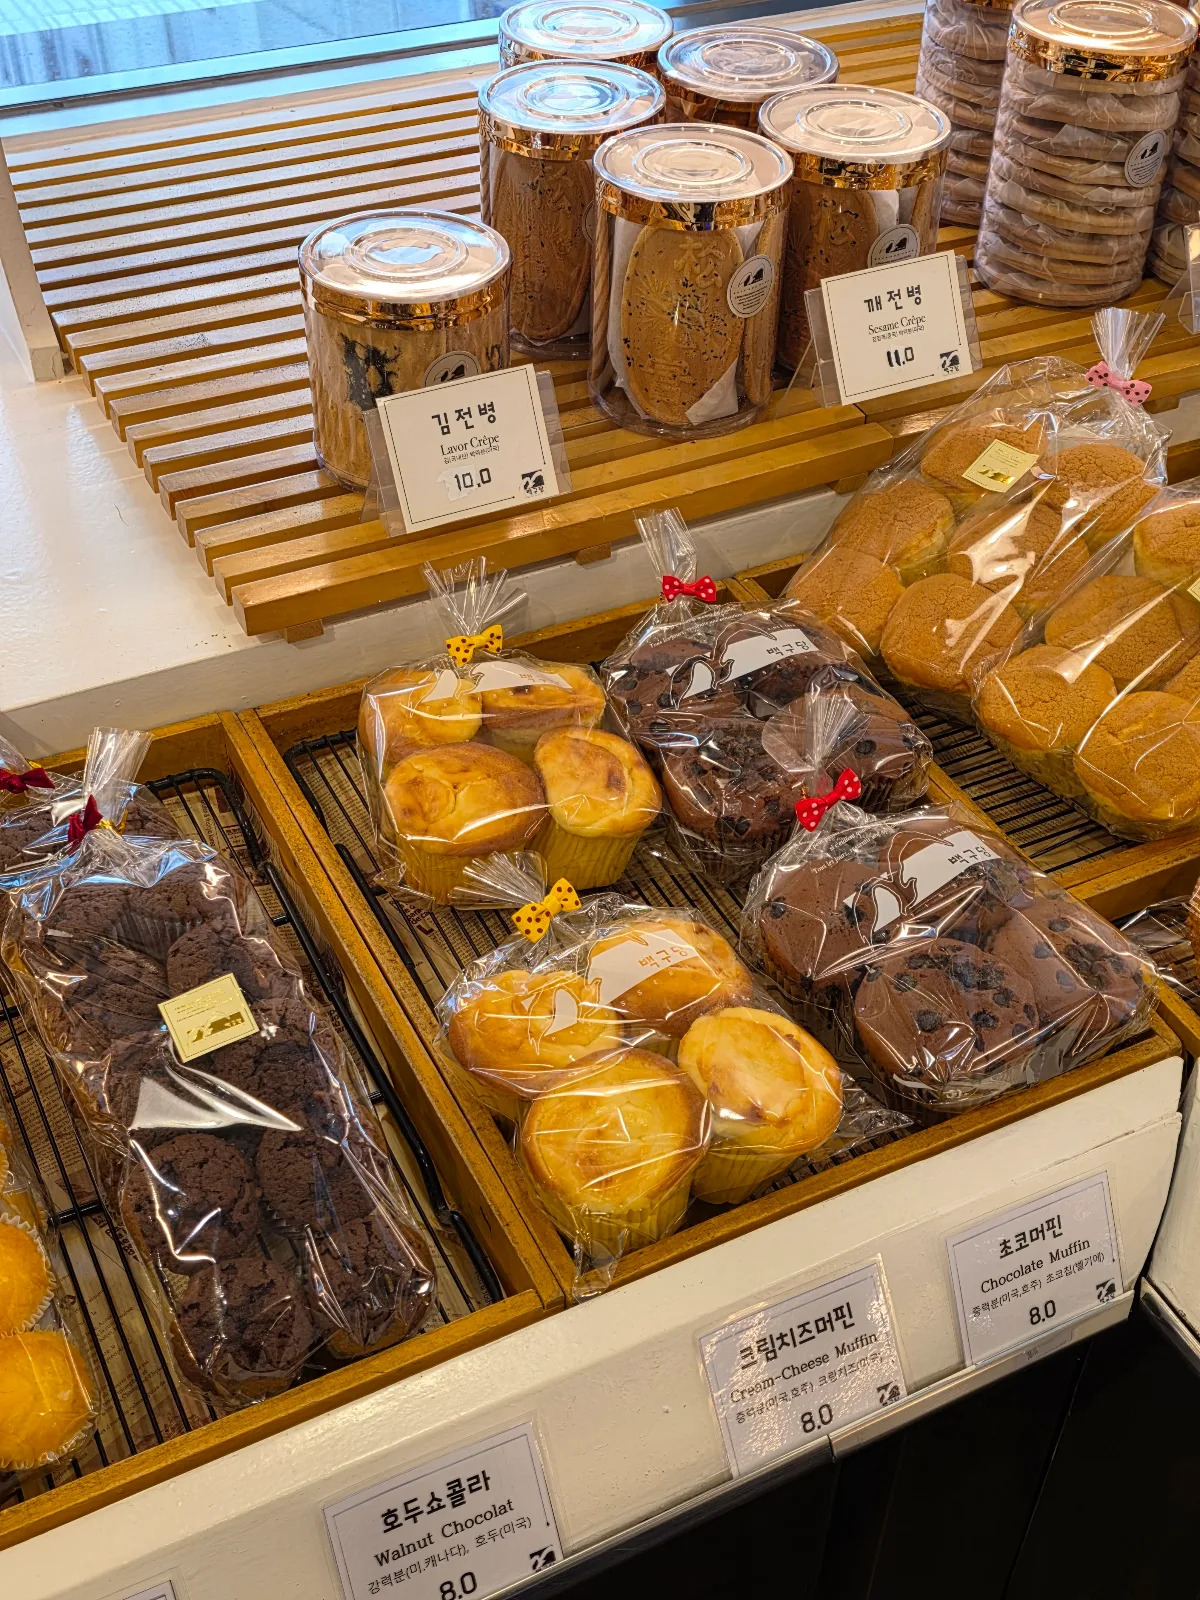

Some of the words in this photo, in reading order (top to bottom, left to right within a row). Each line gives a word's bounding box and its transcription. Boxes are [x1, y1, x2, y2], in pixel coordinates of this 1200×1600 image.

[864, 284, 922, 312] 깨전병
[868, 321, 899, 336] Sesame
[900, 315, 927, 328] Crêpe
[886, 346, 915, 368] 11.0
[431, 401, 497, 436] 김전병
[440, 442, 469, 457] Lavor
[470, 435, 499, 452] Crêpe
[454, 467, 492, 492] 10.0
[766, 640, 810, 657] 백구당
[948, 846, 992, 864] 백구당
[638, 946, 689, 968] 백구당
[999, 1214, 1064, 1259] 초코머핀
[980, 1258, 1044, 1294] Chocolate
[1049, 1238, 1091, 1264] Muffin
[1046, 1252, 1105, 1284] 초코칩(벨기에)
[1029, 1299, 1057, 1325] 8.0
[739, 1302, 856, 1370] 크림치즈머핀
[730, 1352, 830, 1403] Cream-Cheese
[835, 1332, 878, 1359] Muffin
[800, 1403, 834, 1434] 8.0
[381, 1469, 491, 1534] 호두쇼콜라
[374, 1532, 435, 1567] Walnut
[441, 1499, 515, 1539] Chocolat
[475, 1516, 532, 1548] 호두(미국)
[439, 1571, 478, 1600] 8.0
